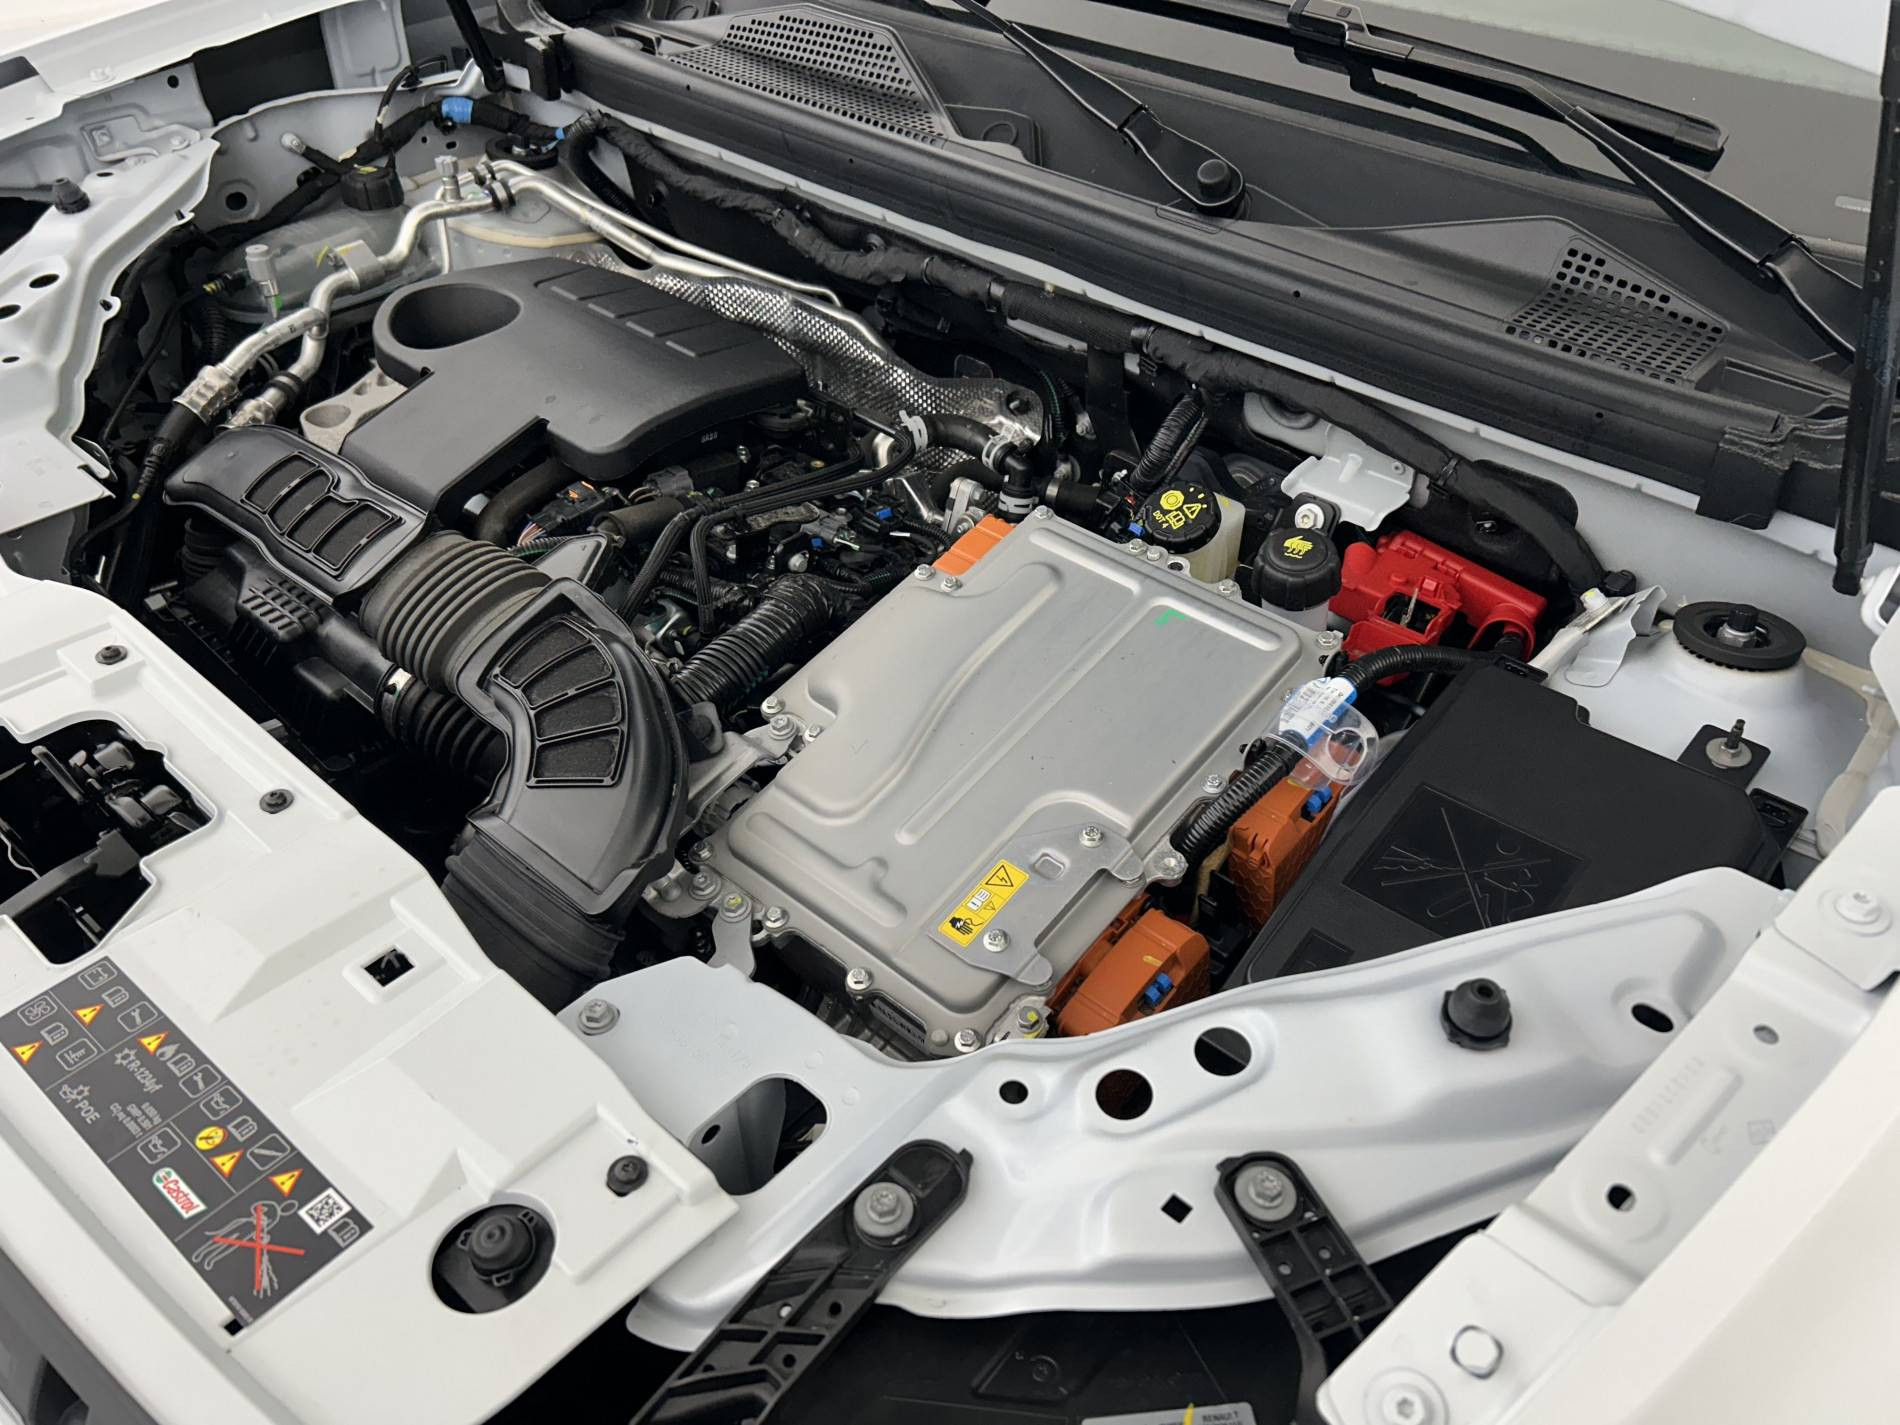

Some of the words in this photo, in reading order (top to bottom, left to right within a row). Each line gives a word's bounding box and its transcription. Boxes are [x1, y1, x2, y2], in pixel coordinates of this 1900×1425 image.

[1153, 510, 1166, 523] DOT
[127, 1060, 163, 1093] R-1234yf
[75, 1100, 100, 1124] POE
[162, 1178, 199, 1213] Castrol
